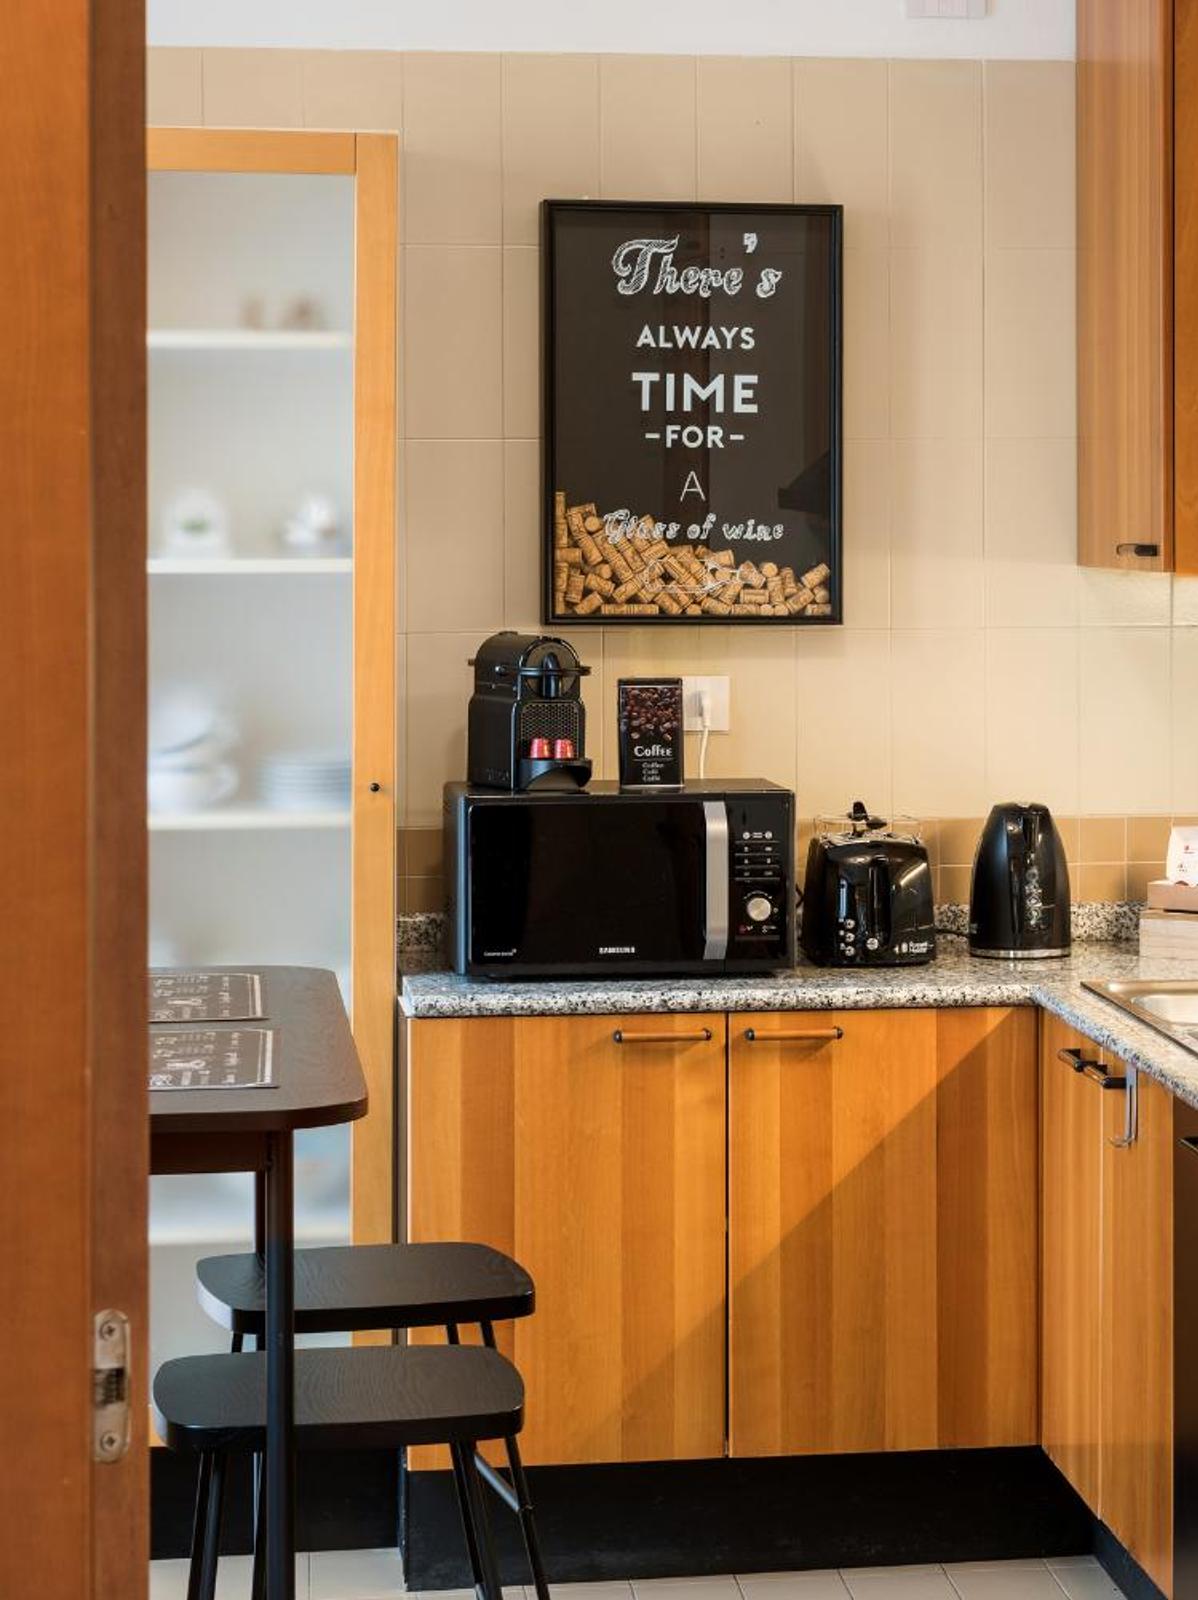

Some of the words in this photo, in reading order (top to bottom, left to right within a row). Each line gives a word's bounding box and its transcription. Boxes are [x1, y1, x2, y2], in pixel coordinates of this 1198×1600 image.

[636, 325, 755, 349] ALWAYS
[632, 372, 758, 413] TIME
[680, 471, 706, 502] A
[687, 513, 717, 540] of
[722, 519, 785, 541] wine
[634, 744, 672, 757] Coffee
